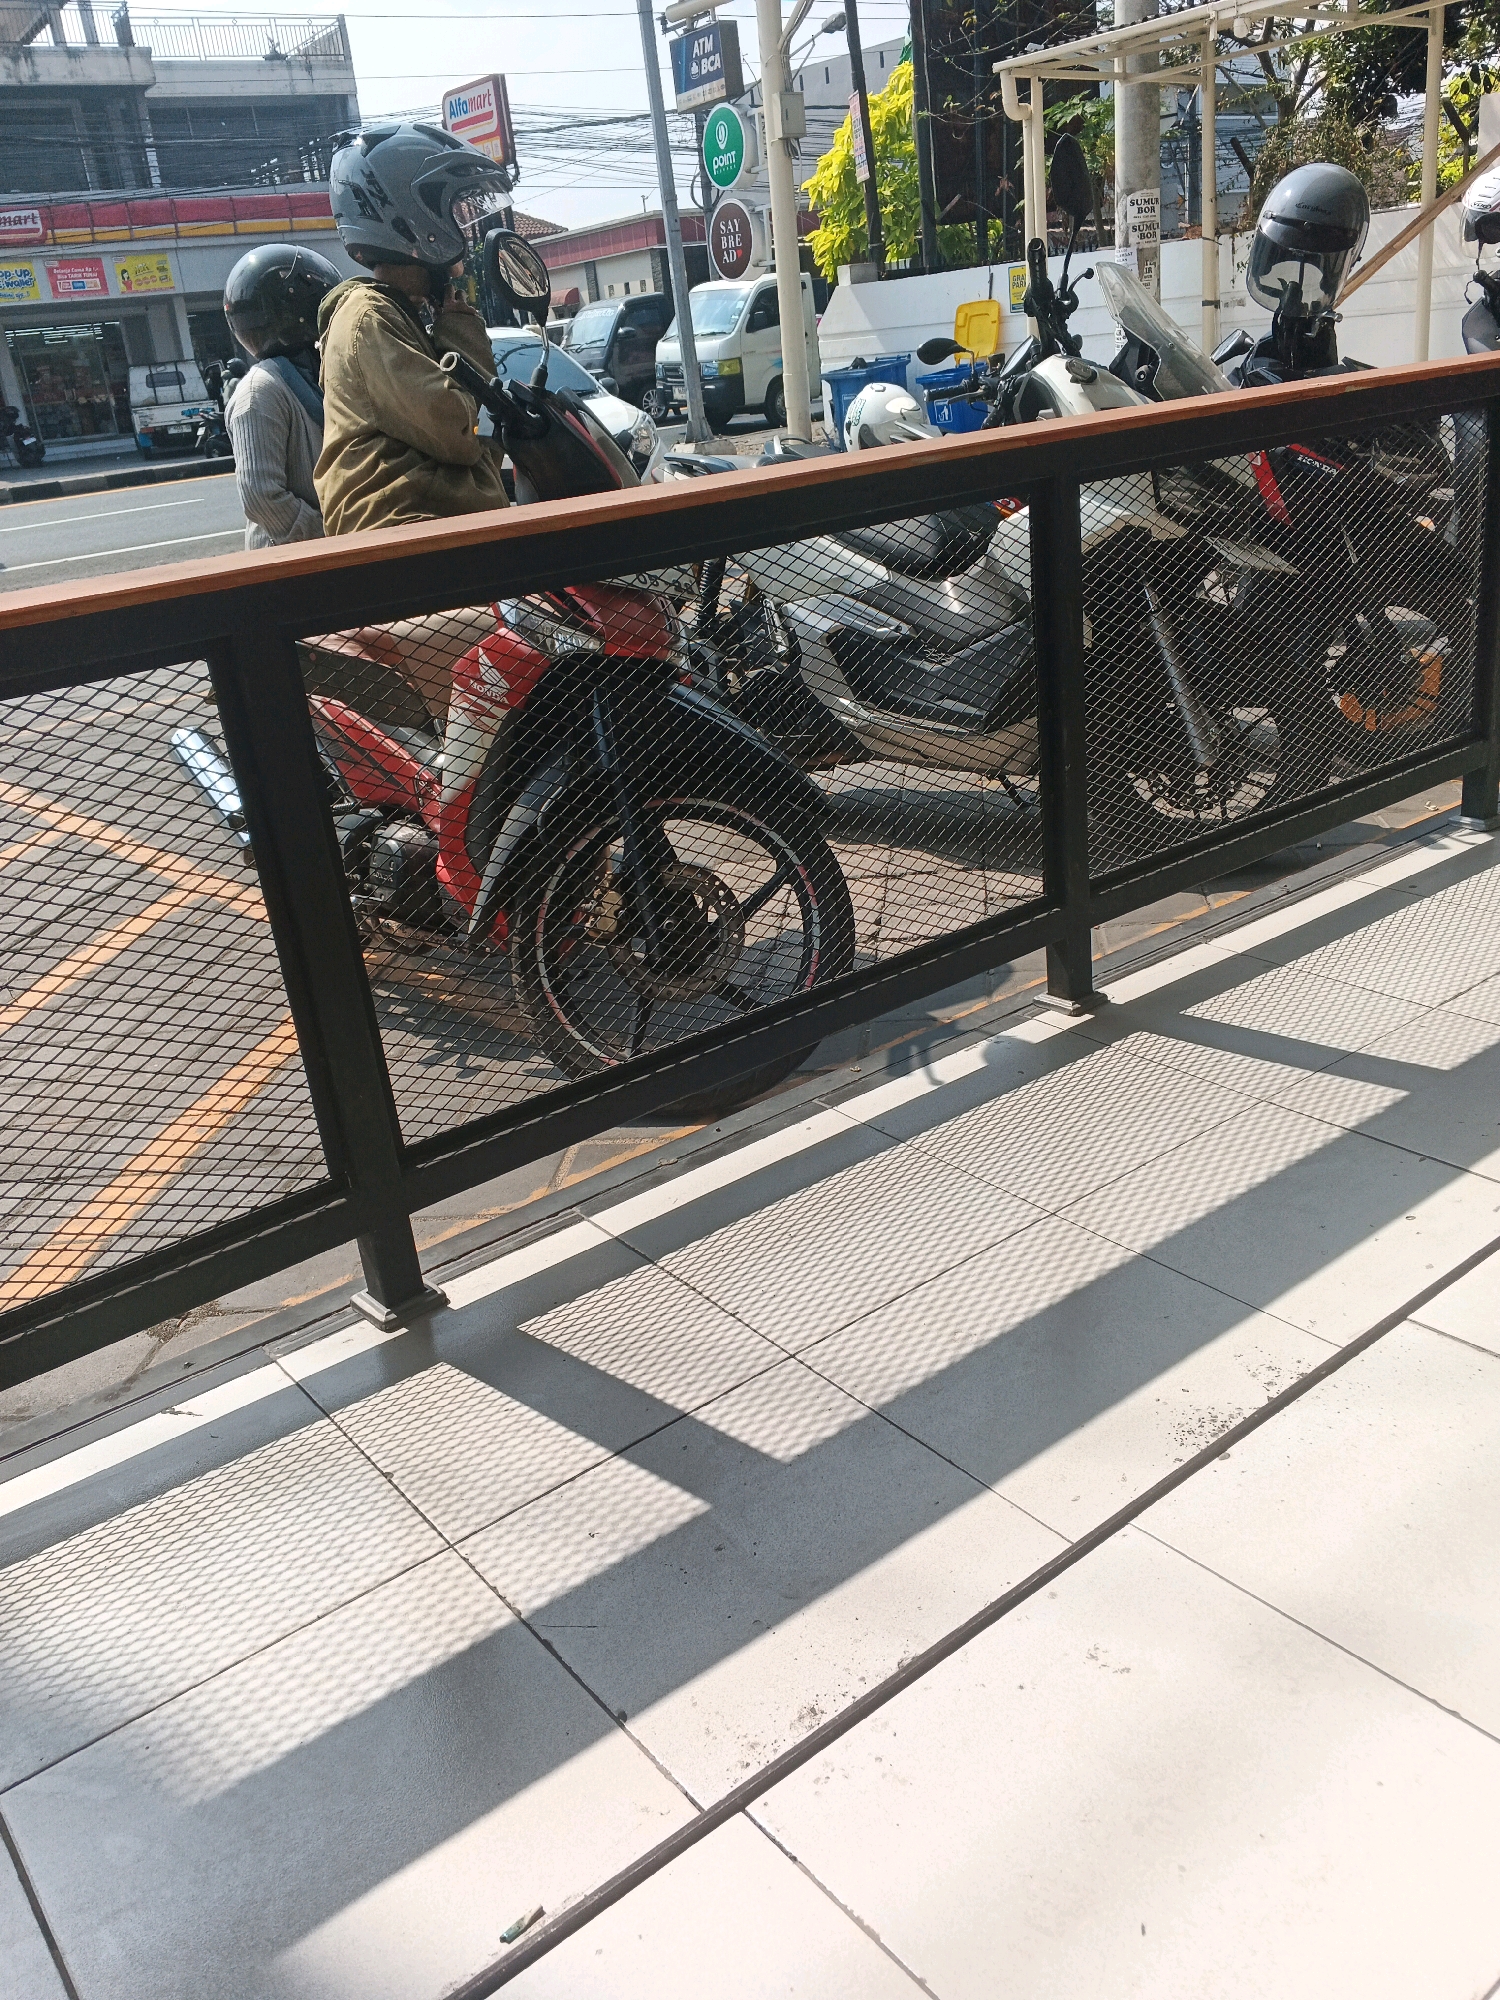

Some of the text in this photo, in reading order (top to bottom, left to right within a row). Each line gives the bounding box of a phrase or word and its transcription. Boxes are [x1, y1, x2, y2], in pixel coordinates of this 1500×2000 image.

[693, 34, 714, 58] ATM
[701, 53, 721, 75] BCA
[449, 89, 492, 119] Alfamart
[1137, 206, 1156, 214] BOR
[720, 219, 741, 234] SAY
[721, 234, 742, 249] BRE
[1139, 231, 1157, 240] BOR
[723, 249, 737, 264] AD
[1012, 273, 1026, 282] GRA
[1297, 454, 1338, 475] HONDA
[469, 679, 510, 705] HONDA
